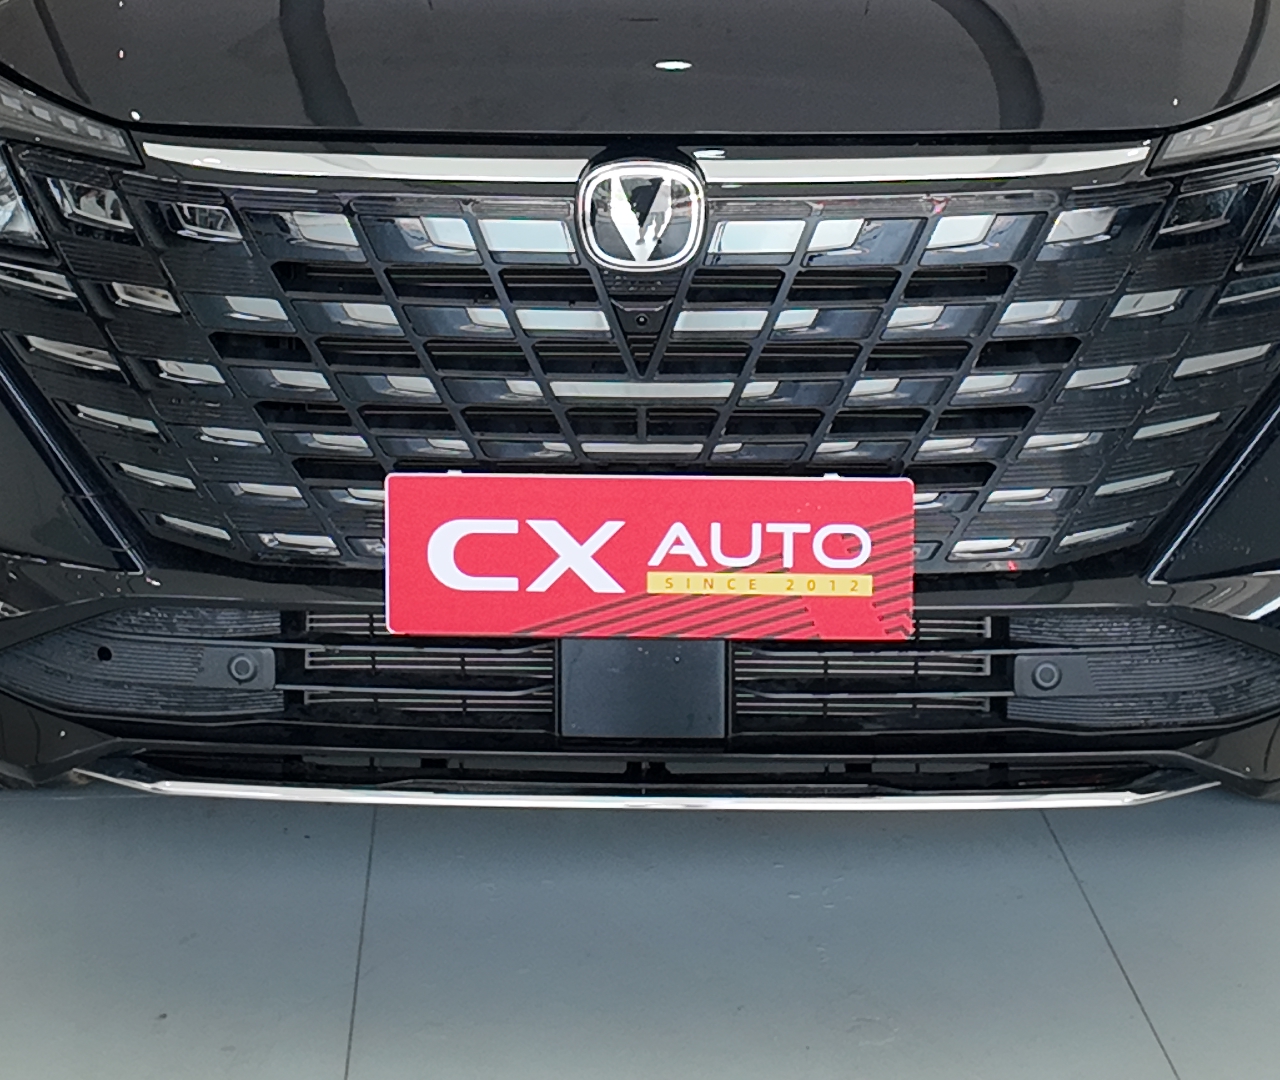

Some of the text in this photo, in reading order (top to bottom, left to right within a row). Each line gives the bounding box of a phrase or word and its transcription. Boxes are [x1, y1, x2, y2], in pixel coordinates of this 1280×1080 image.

[426, 518, 872, 593] CX AUTO
[665, 576, 860, 592] SINCE 2012
